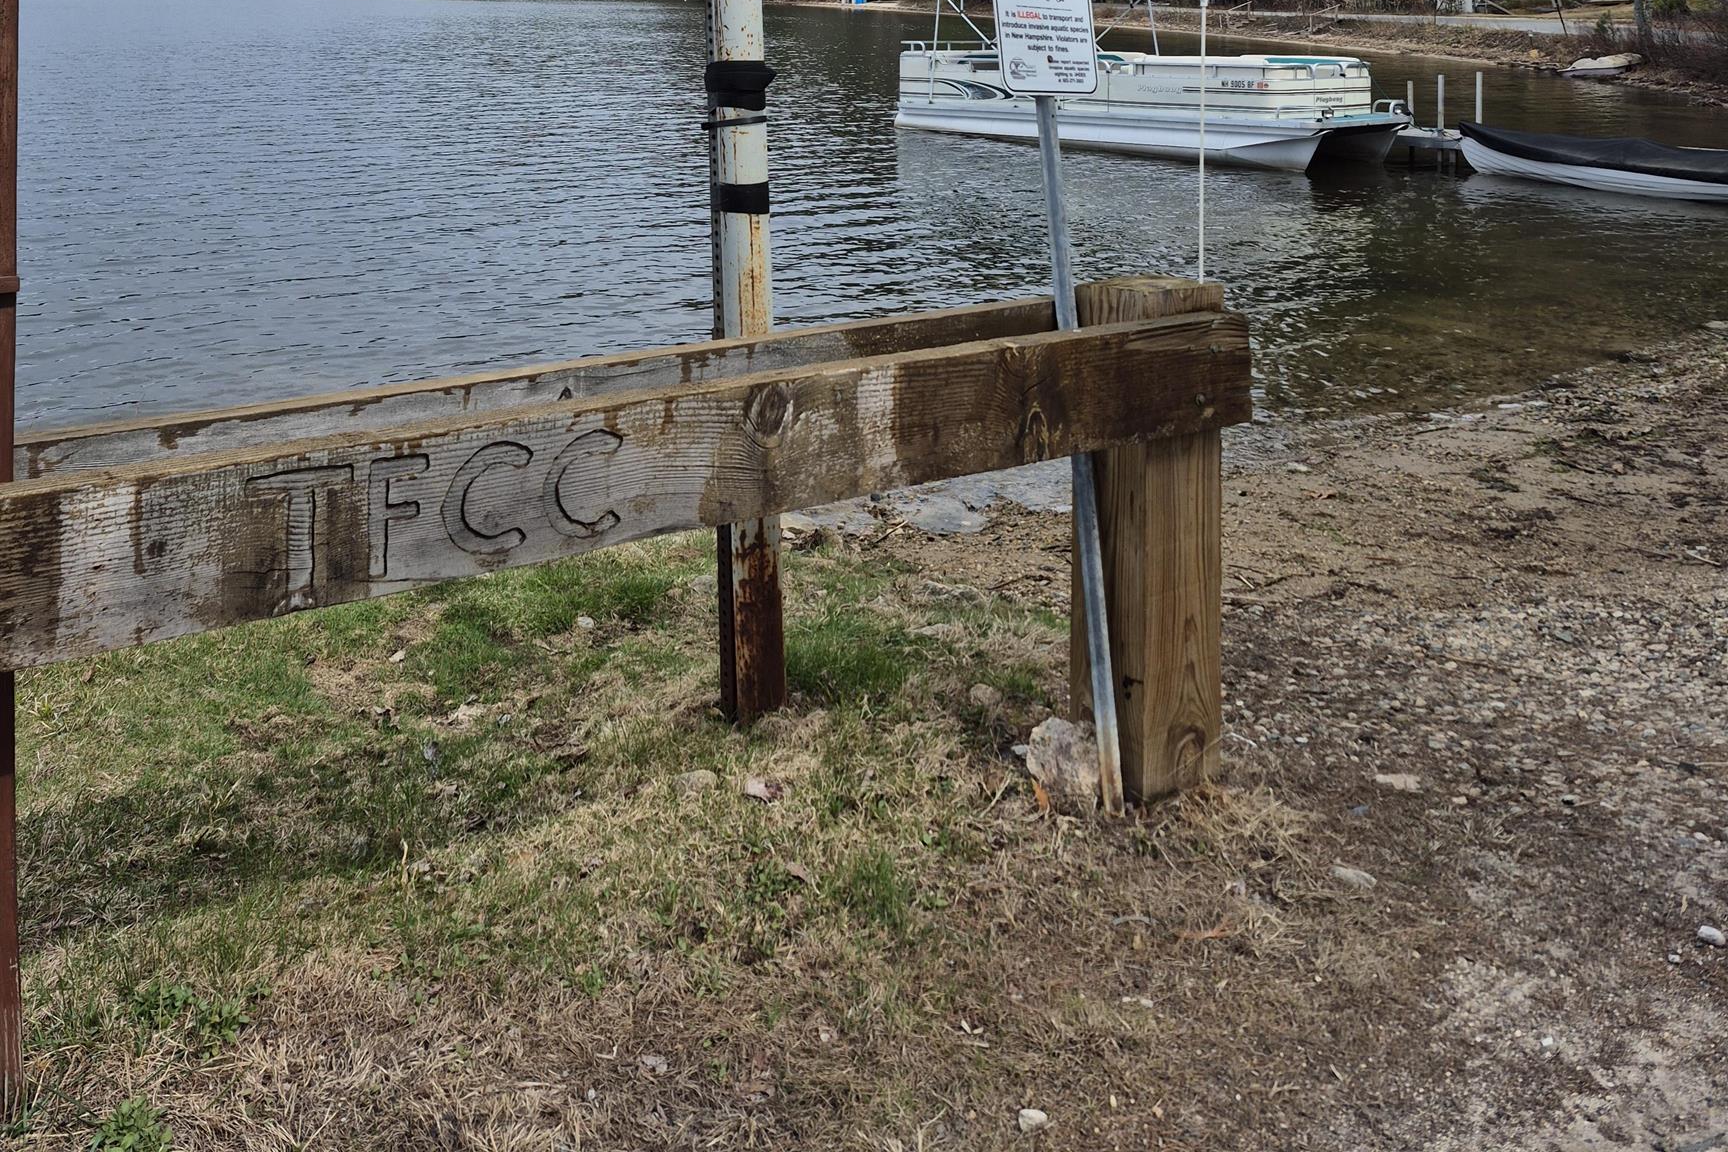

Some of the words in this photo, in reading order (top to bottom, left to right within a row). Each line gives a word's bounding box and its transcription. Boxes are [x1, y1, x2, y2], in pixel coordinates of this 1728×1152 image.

[1017, 11, 1041, 19] ILLEGAL
[1049, 14, 1072, 22] transport
[1051, 24, 1068, 33] aquatic
[1056, 35, 1078, 43] Violators
[1230, 80, 1246, 88] 9005
